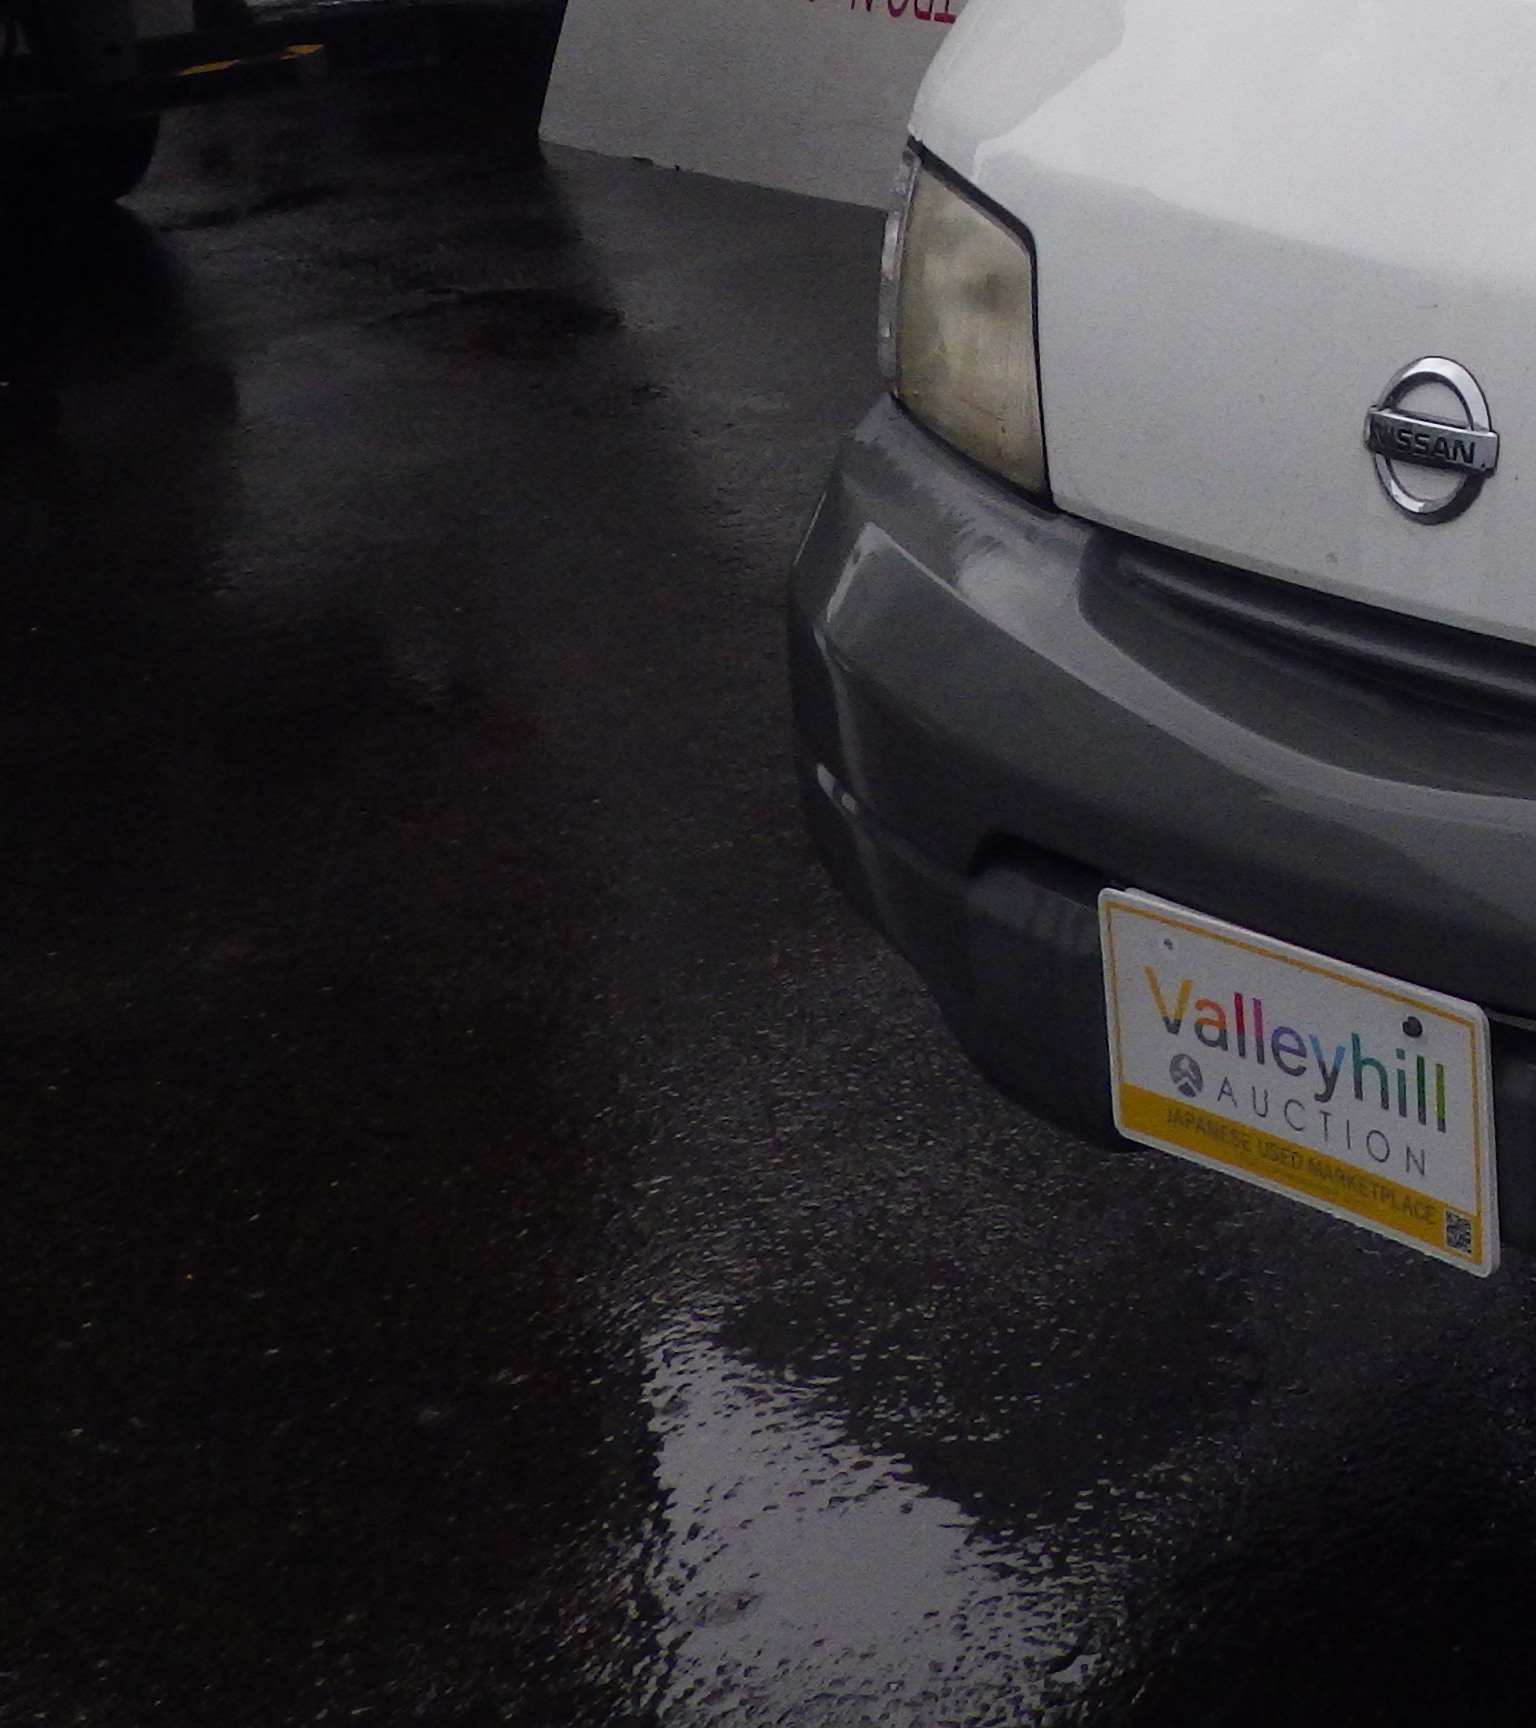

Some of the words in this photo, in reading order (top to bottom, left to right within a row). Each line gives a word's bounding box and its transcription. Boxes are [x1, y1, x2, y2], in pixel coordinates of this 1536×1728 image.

[1370, 421, 1476, 465] NISSAN
[1144, 964, 1447, 1134] Valleyhill
[1216, 1075, 1426, 1177] AUCTION
